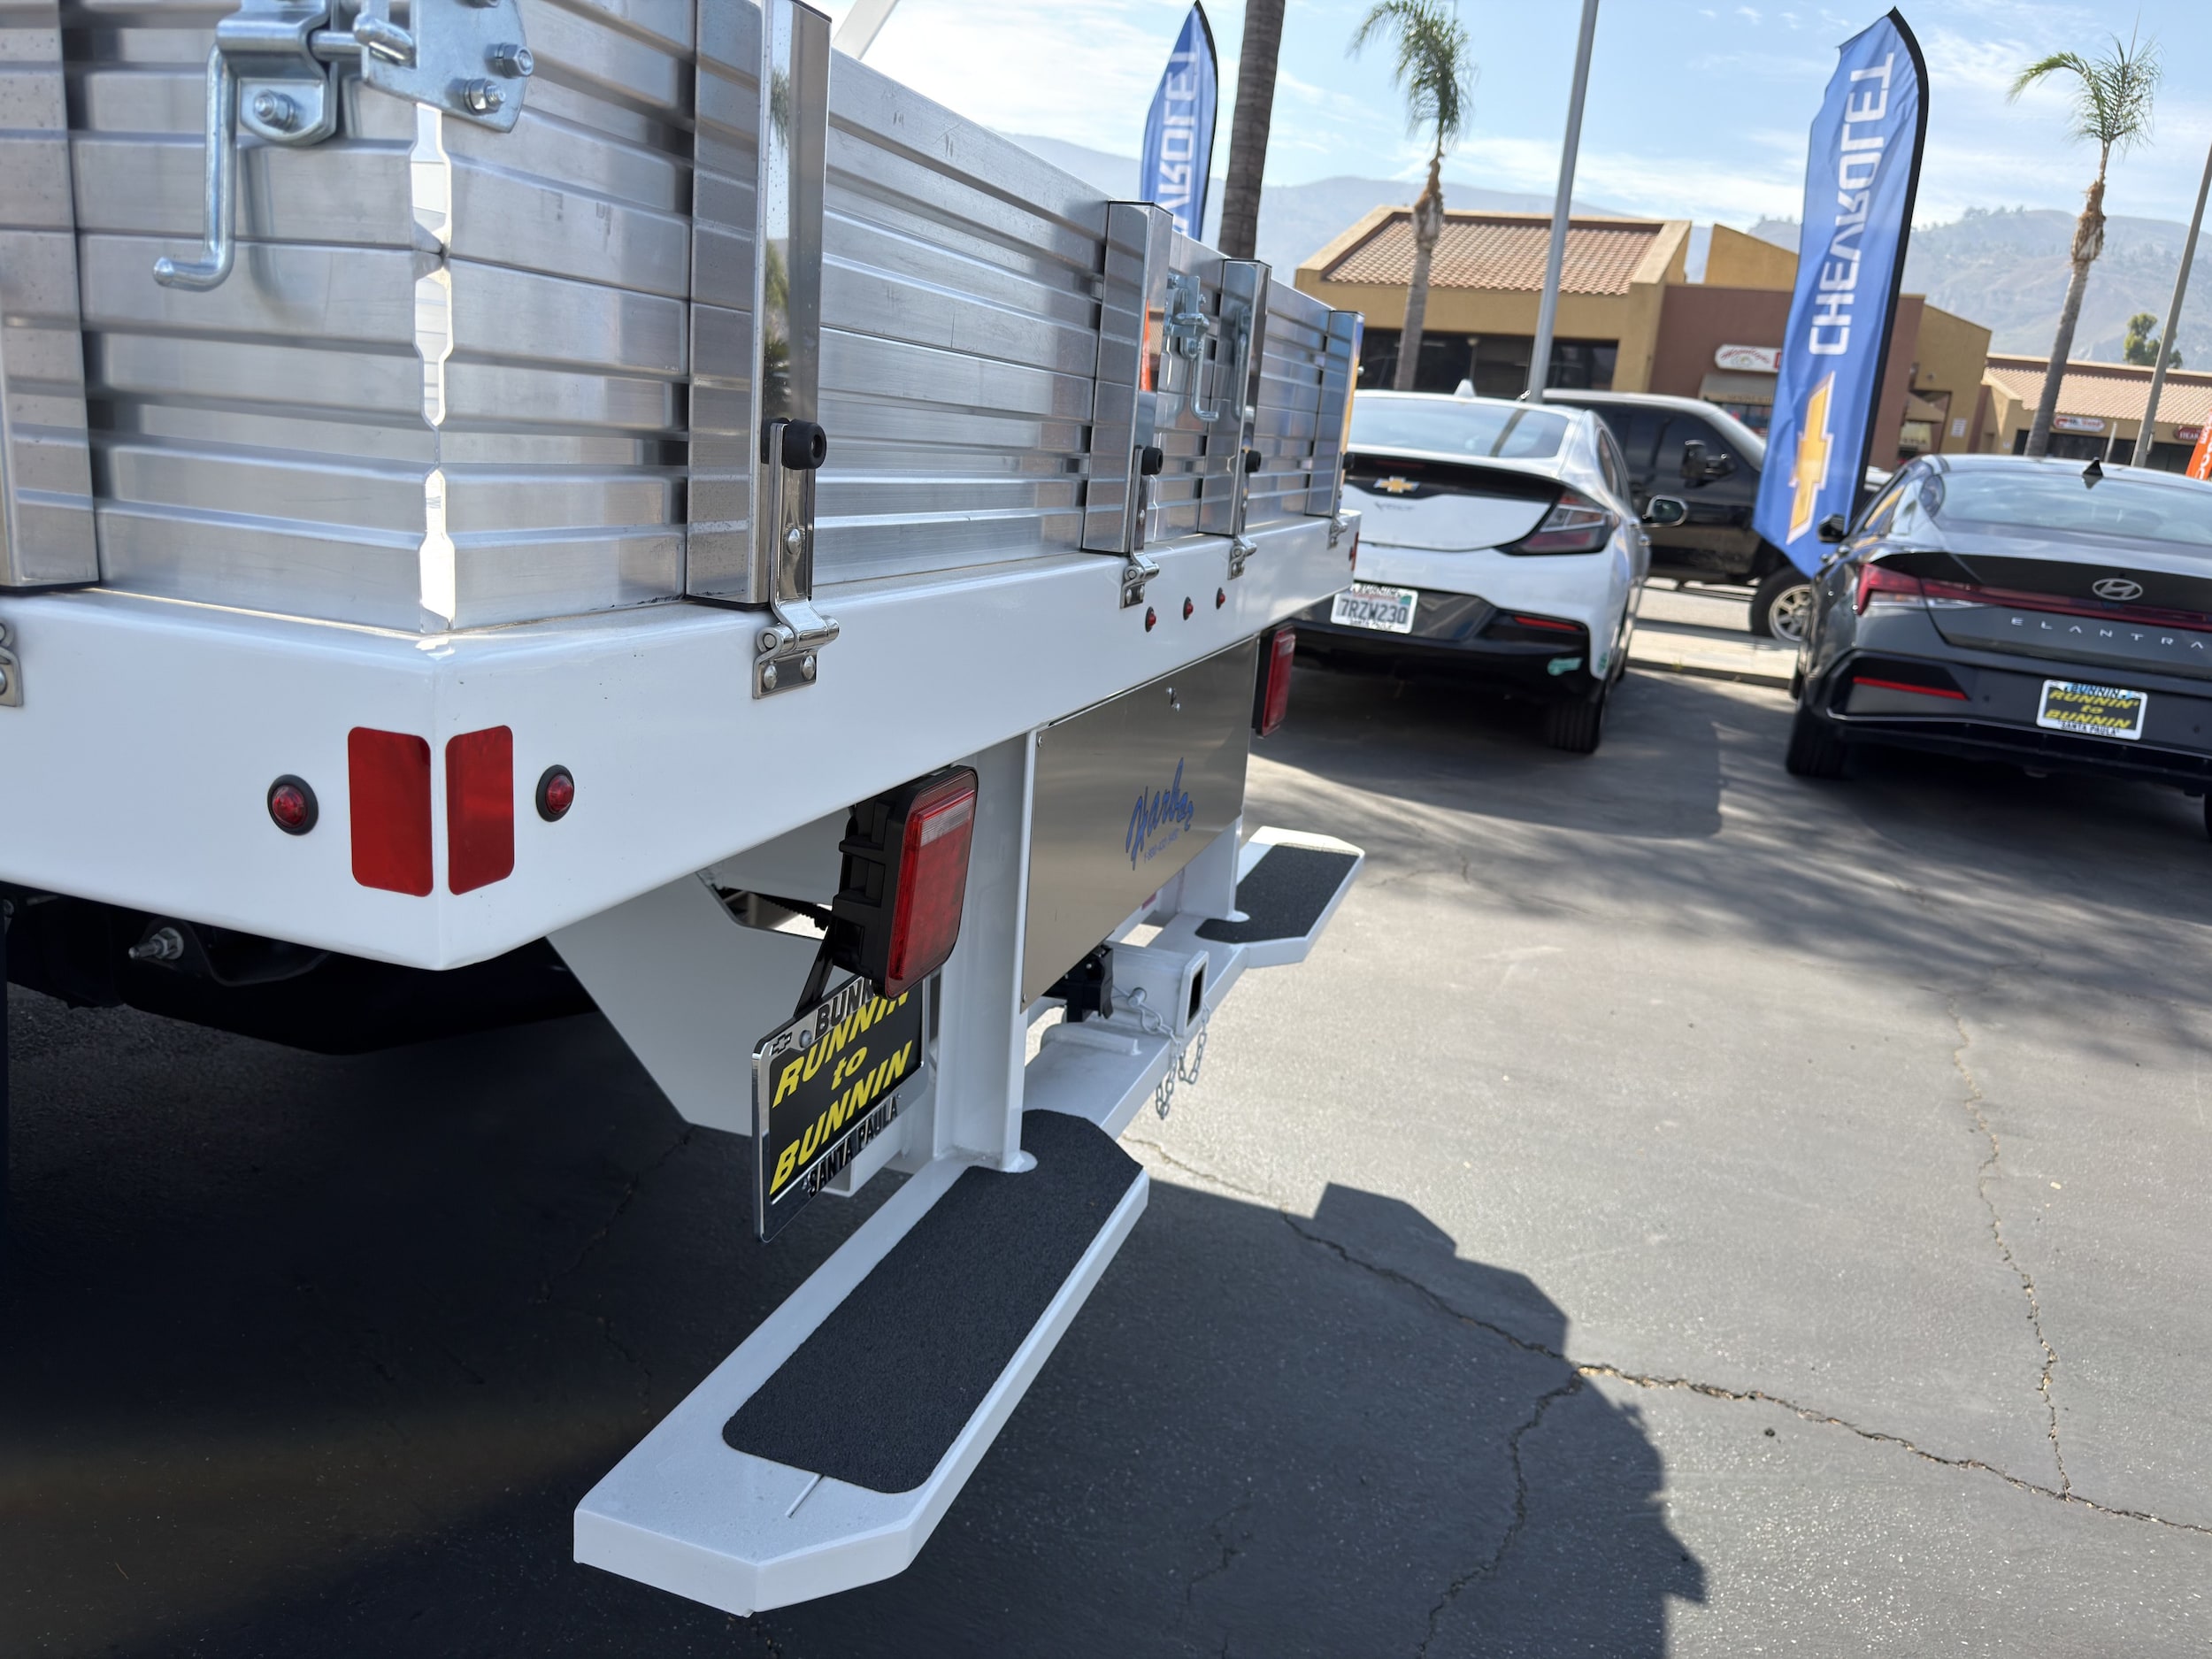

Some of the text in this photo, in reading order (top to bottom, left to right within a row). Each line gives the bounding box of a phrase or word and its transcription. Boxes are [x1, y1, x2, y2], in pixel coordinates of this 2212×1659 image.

[1338, 598, 1409, 625] 7RZW230
[2011, 617, 2204, 650] ELANTRA
[2045, 709, 2132, 729] BUNNIN
[2080, 704, 2104, 715] to
[831, 1046, 868, 1091] to
[769, 1040, 913, 1196] BUNNIN
